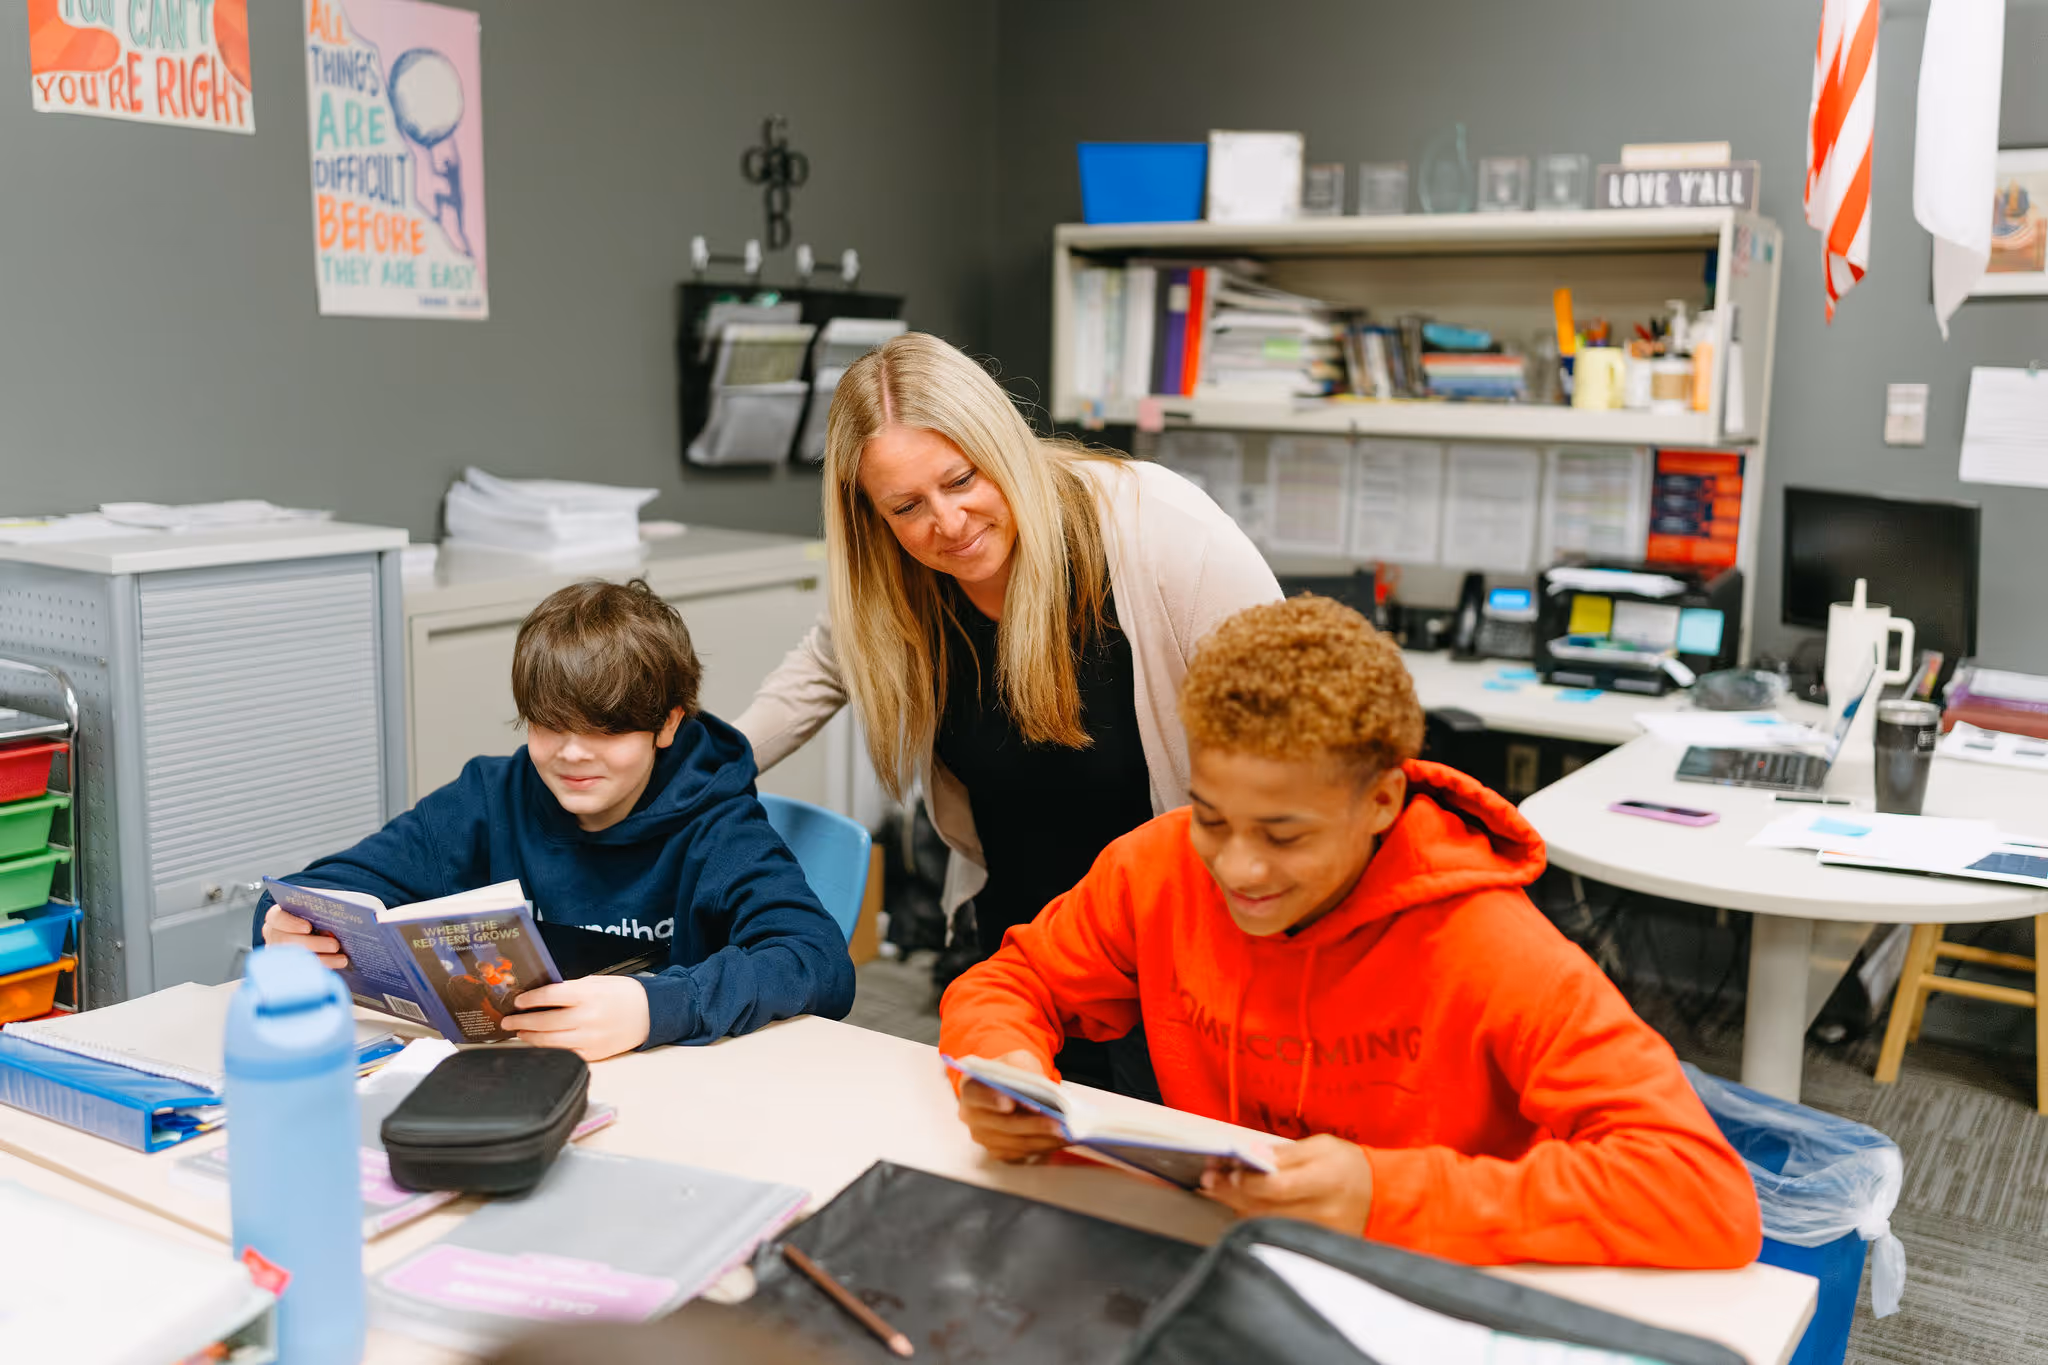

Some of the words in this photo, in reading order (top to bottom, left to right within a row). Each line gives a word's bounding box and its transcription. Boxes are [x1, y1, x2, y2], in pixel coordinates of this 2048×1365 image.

[127, 0, 214, 50] CANT
[310, 0, 350, 45] ALL
[36, 52, 143, 113] YOU'RE
[156, 53, 245, 126] RIGHT
[311, 45, 380, 97] THINGS
[315, 91, 386, 150] ARE
[314, 154, 409, 209] DIFFICULT
[1609, 172, 1669, 208] LOVE
[1678, 169, 1745, 205] Y'ALL
[318, 193, 427, 257] BEFORE
[321, 256, 371, 286] THEY
[381, 260, 417, 288] ARE
[431, 262, 477, 290] EASY
[412, 937, 437, 949] RED
[439, 933, 471, 946] FERN
[473, 927, 520, 943] GROWS
[423, 923, 470, 937] WHERE
[471, 920, 499, 931] THE
[1169, 968, 1422, 1067] OMECOMING
